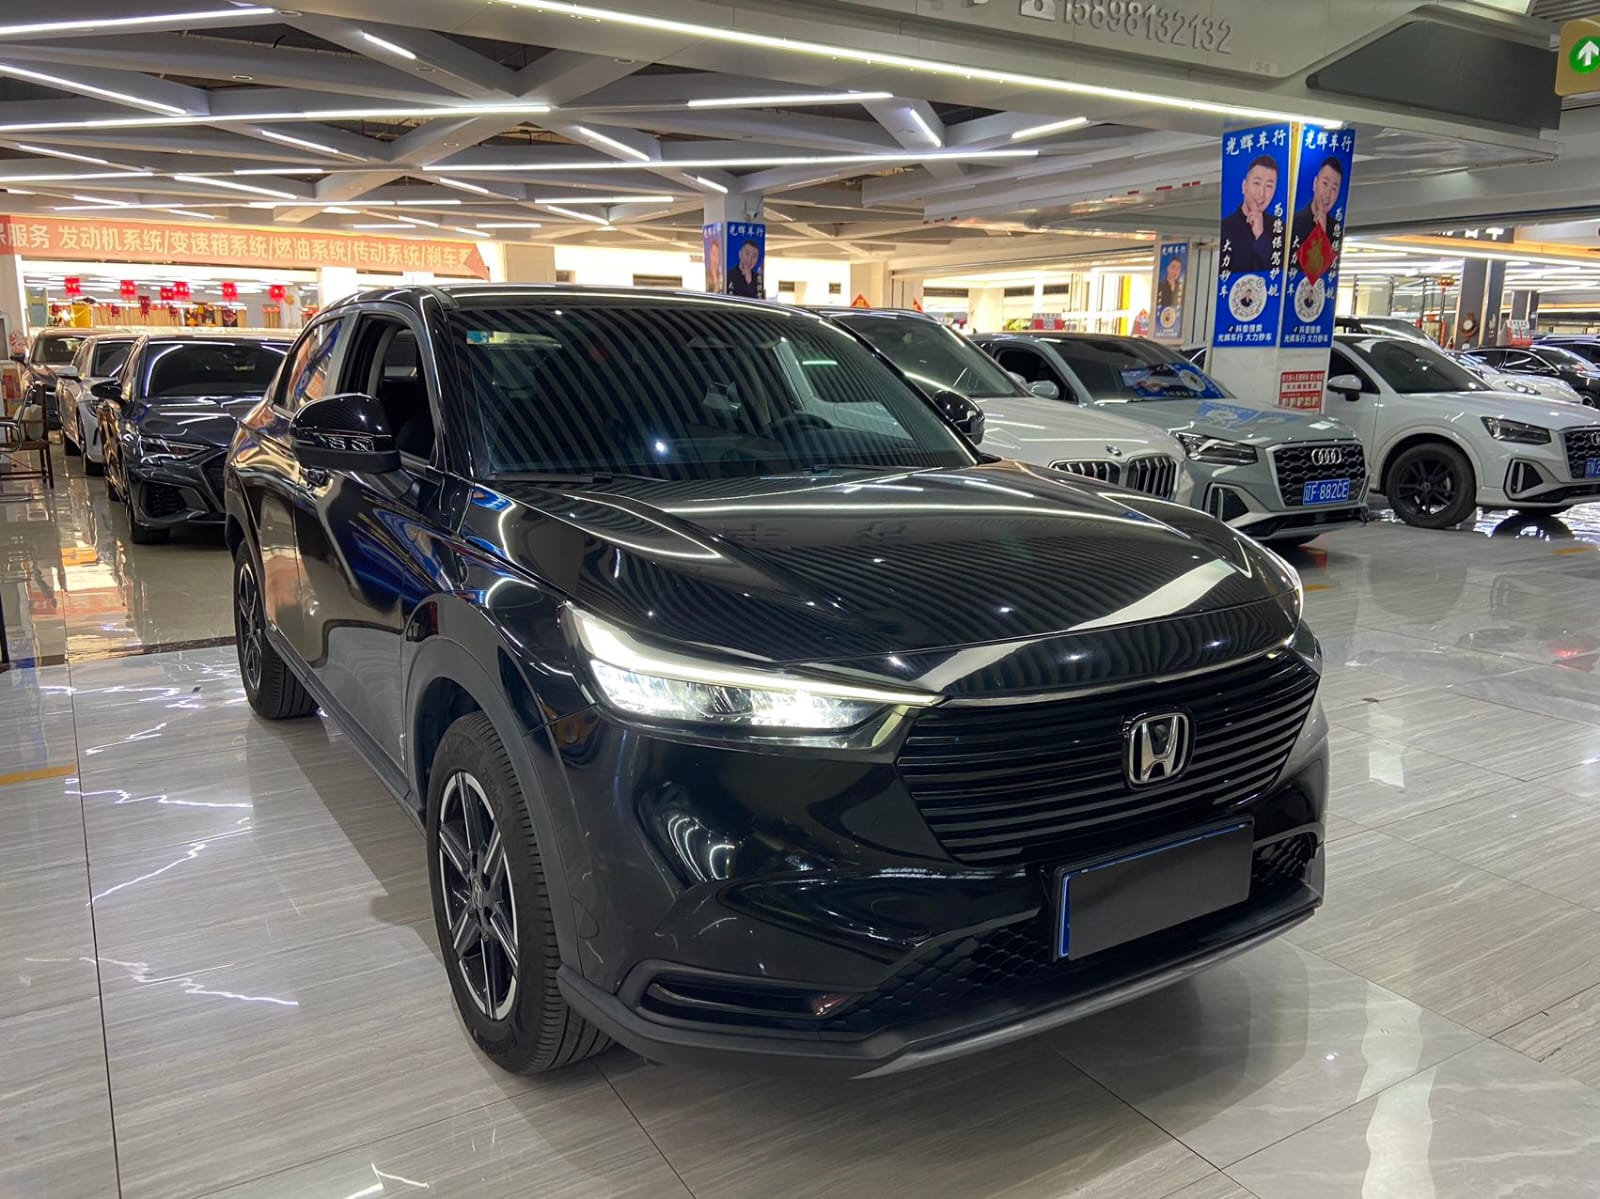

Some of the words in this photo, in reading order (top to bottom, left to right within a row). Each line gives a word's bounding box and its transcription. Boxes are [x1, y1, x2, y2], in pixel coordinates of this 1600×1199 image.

[1225, 129, 1287, 156] 光辉车行
[1305, 129, 1353, 153] 光辉车行
